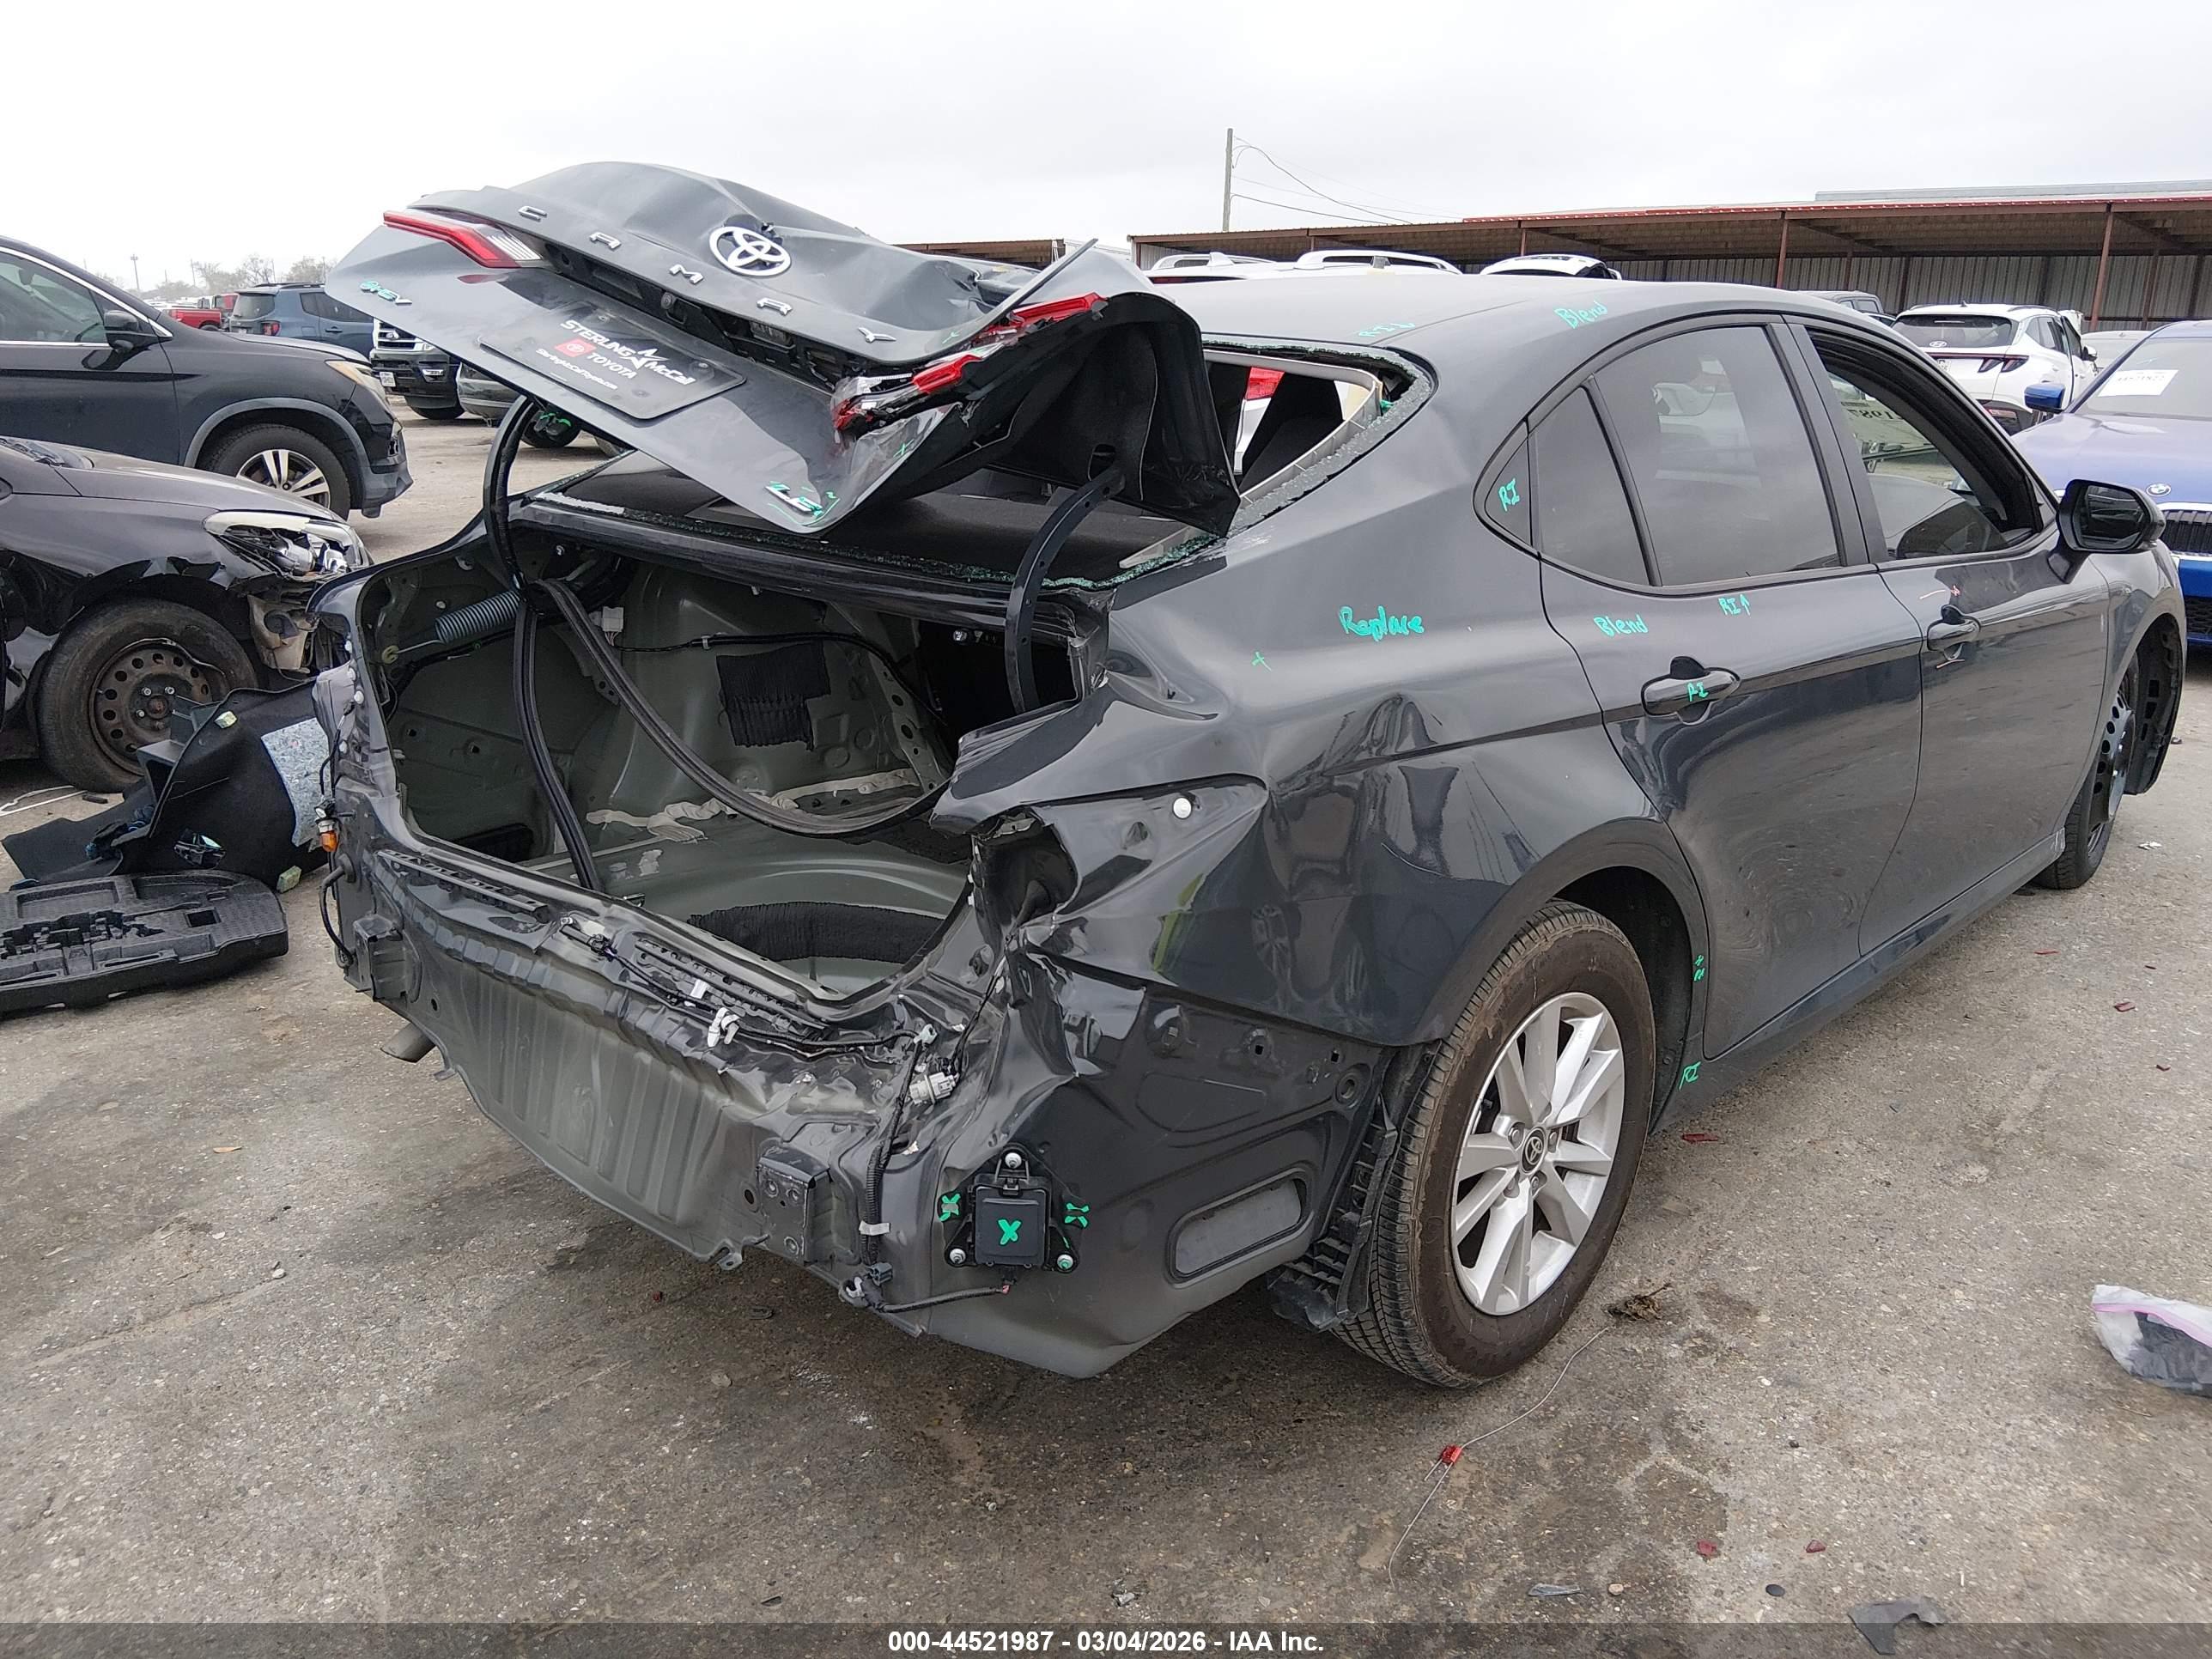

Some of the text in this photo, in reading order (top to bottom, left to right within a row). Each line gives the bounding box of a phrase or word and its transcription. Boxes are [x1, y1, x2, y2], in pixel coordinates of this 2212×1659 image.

[518, 205, 896, 344] CAMRY
[1554, 301, 1607, 329] Blend
[560, 319, 696, 385] STERLING McCall
[587, 352, 637, 379] TOYOTA
[1339, 605, 1425, 642] Replace
[1593, 614, 1650, 637] Blend
